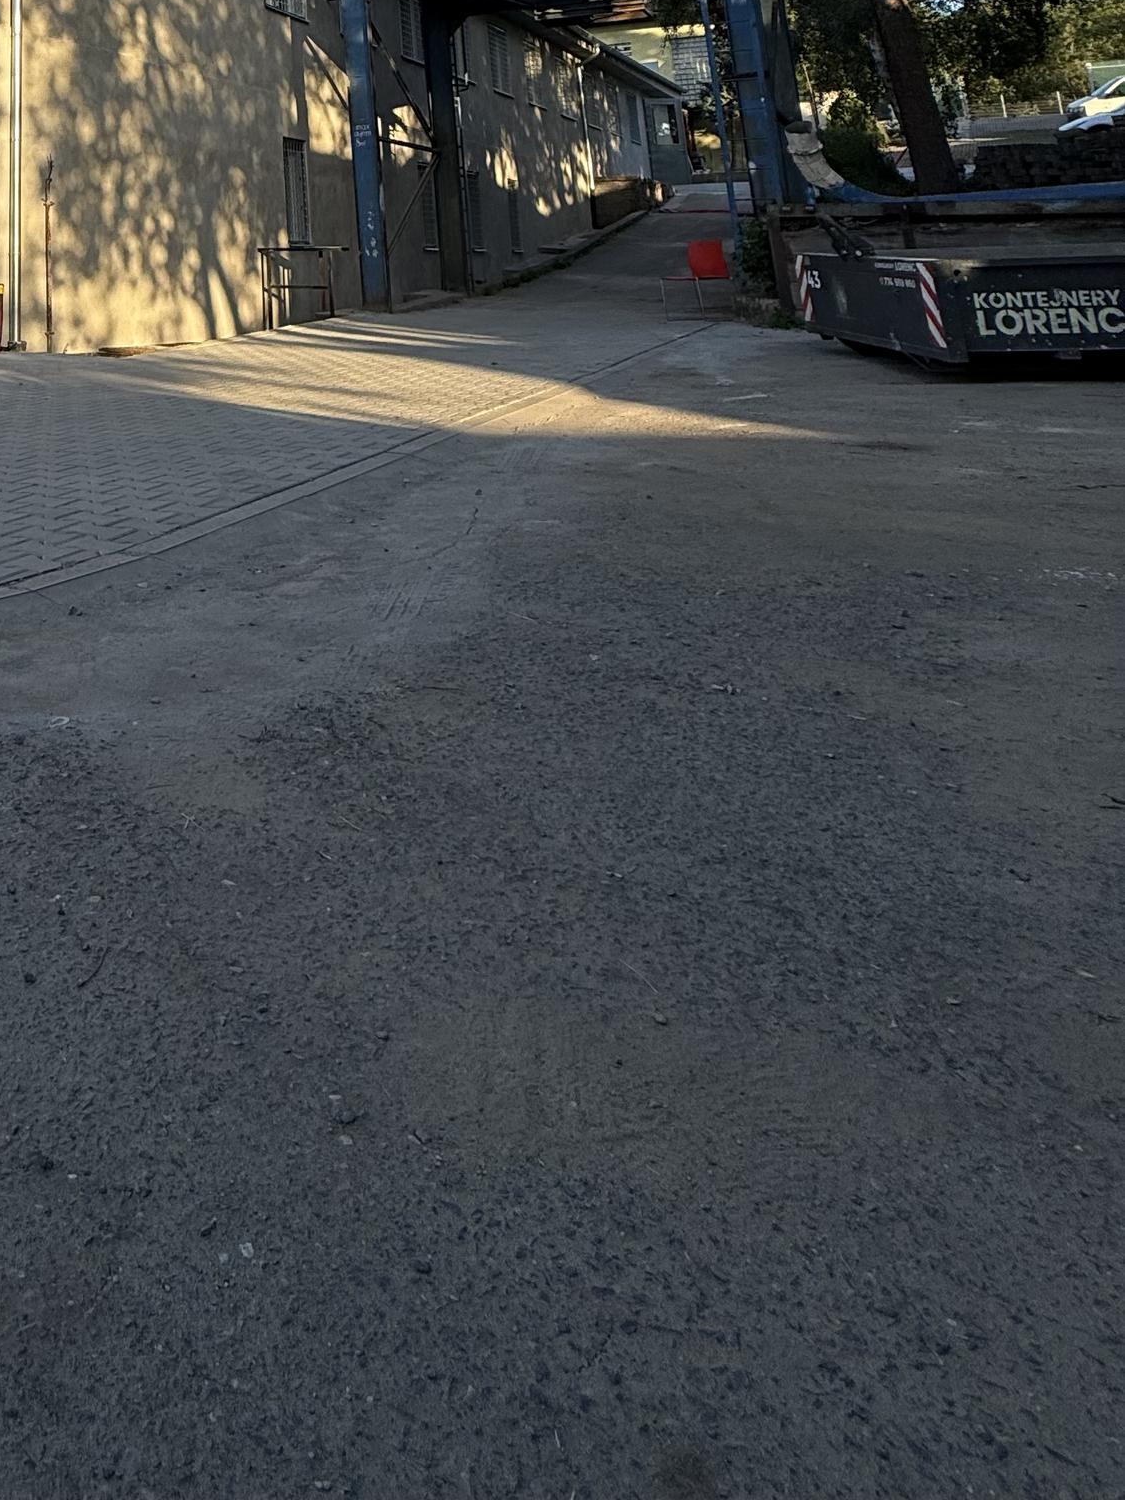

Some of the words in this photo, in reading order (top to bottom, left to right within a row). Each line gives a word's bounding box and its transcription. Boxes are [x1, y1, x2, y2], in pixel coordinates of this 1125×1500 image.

[807, 270, 821, 289] 43
[973, 288, 1120, 308] KONTEJNERY
[976, 307, 1125, 335] LORENC
